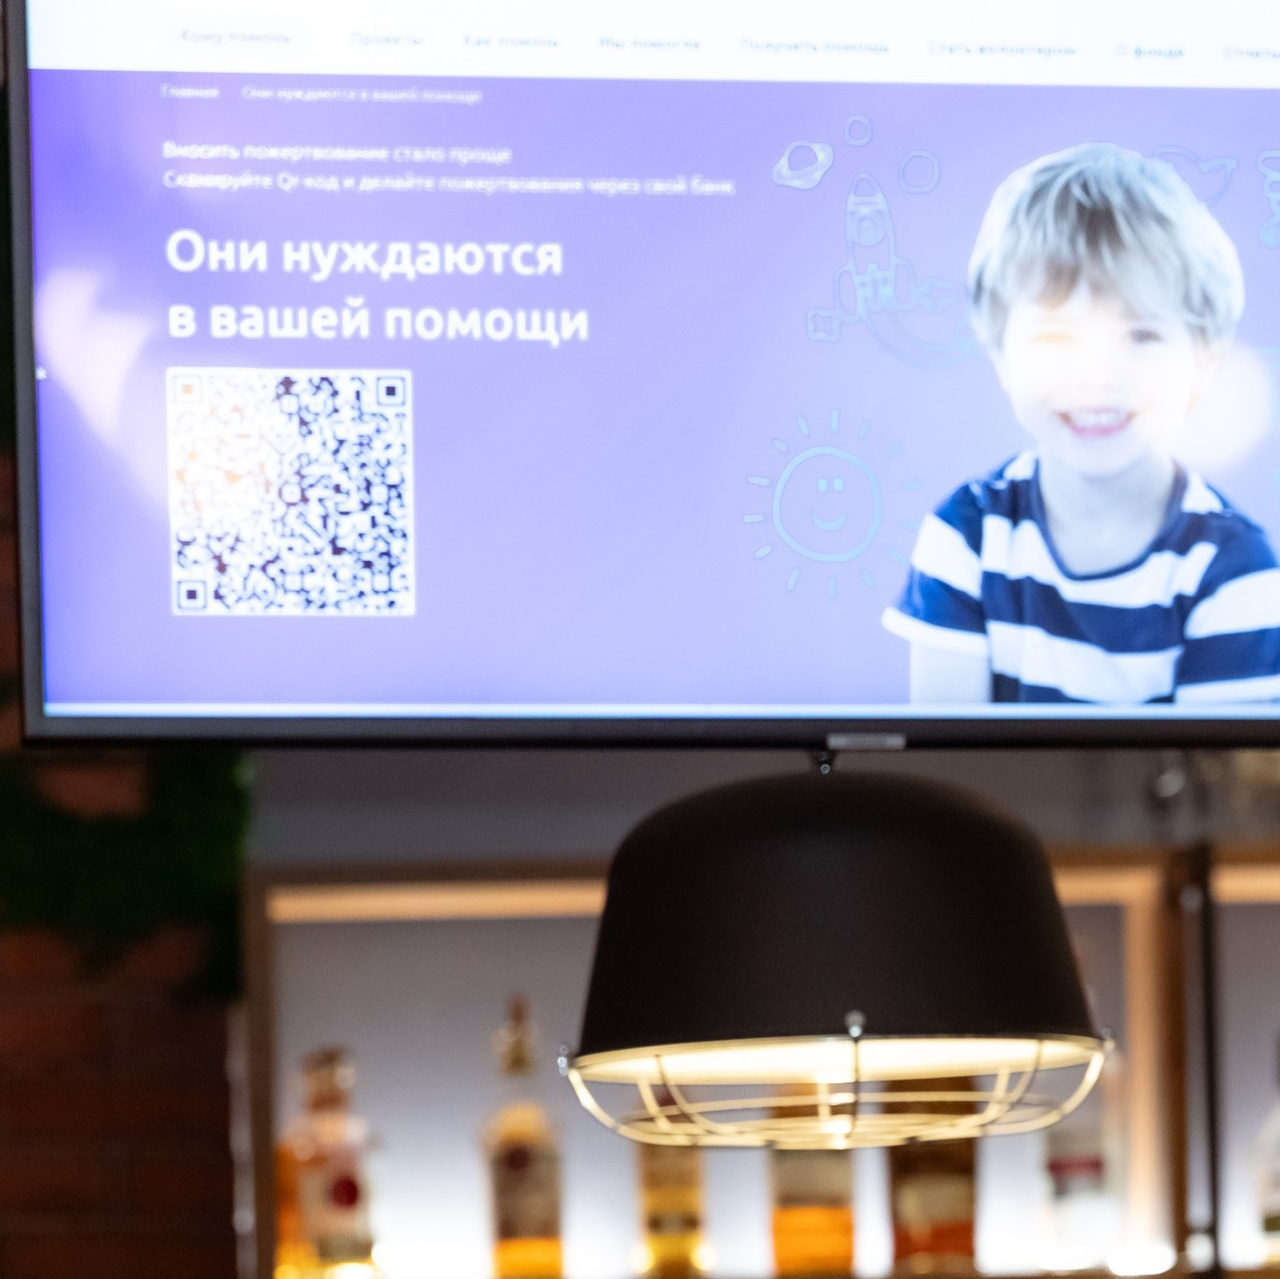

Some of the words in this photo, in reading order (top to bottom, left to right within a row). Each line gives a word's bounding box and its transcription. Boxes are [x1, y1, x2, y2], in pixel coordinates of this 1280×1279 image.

[166, 229, 267, 272] Они
[282, 240, 562, 281] нуждаются
[168, 305, 196, 338] в
[210, 296, 370, 339] вашей
[384, 308, 589, 346] помощи
